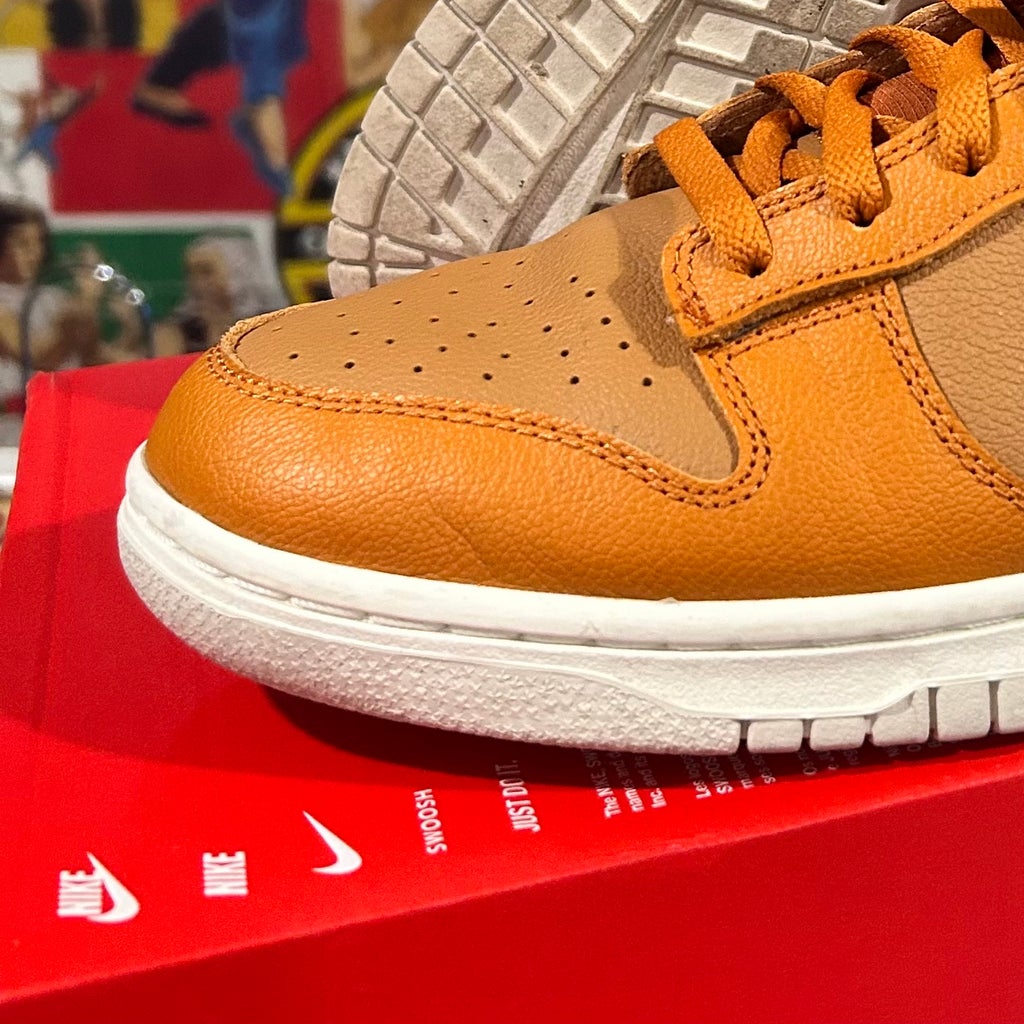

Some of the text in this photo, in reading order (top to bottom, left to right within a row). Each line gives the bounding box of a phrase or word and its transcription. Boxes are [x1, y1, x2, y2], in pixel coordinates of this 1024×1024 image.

[499, 777, 529, 797] DO
[413, 788, 448, 855] SWOOSH
[505, 798, 541, 833] JUST
[603, 796, 622, 819] The
[57, 869, 103, 918] NIKE
[202, 851, 248, 897] NIKE
